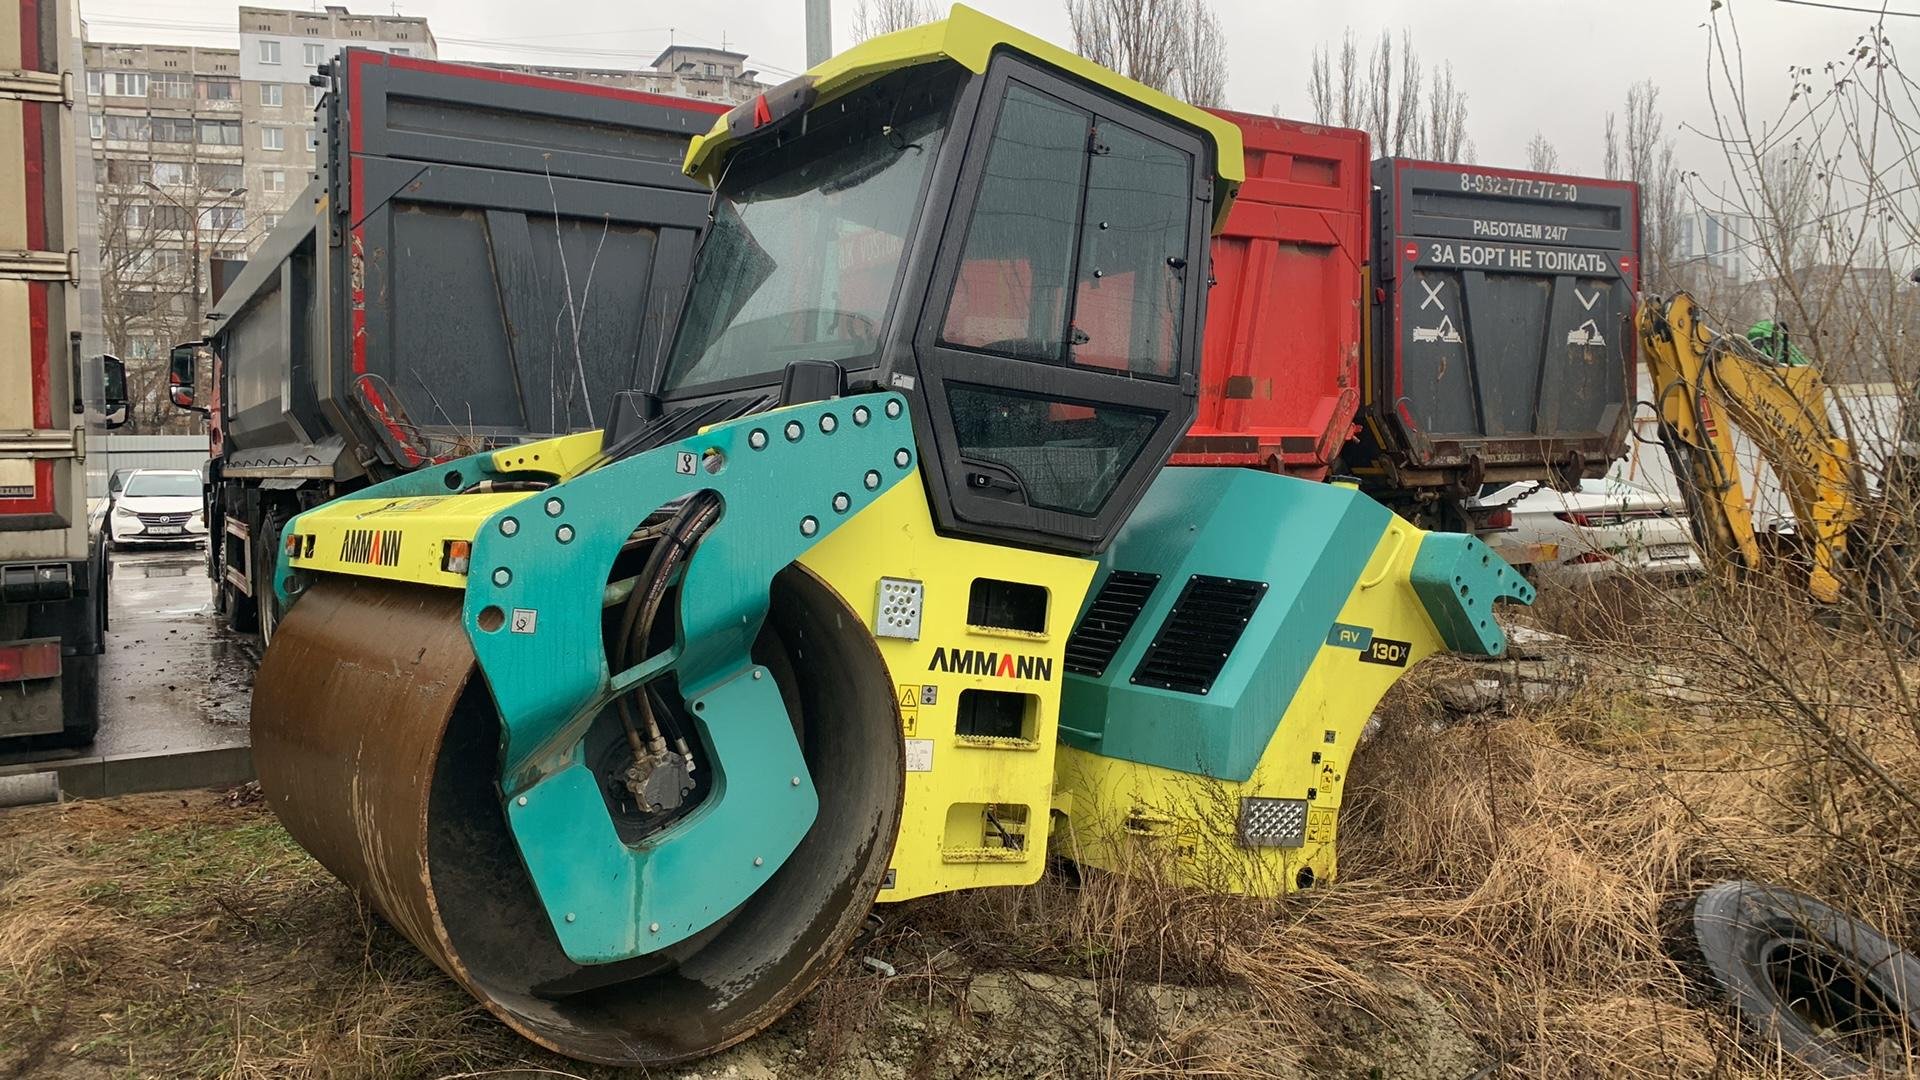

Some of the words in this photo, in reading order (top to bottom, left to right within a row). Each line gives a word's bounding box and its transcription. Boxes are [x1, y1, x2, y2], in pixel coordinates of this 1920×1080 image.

[1473, 220, 1542, 240] РАБОТАЕМ
[1544, 226, 1568, 241] 24/7
[1431, 244, 1456, 263] ЗА
[1459, 245, 1506, 266] БОРТ
[1510, 248, 1532, 268] НЕ
[1536, 250, 1607, 272] ТОЛКАТЬ
[340, 529, 403, 567] AMMANN
[1340, 630, 1360, 644] AV
[928, 646, 1053, 682] AMMANN
